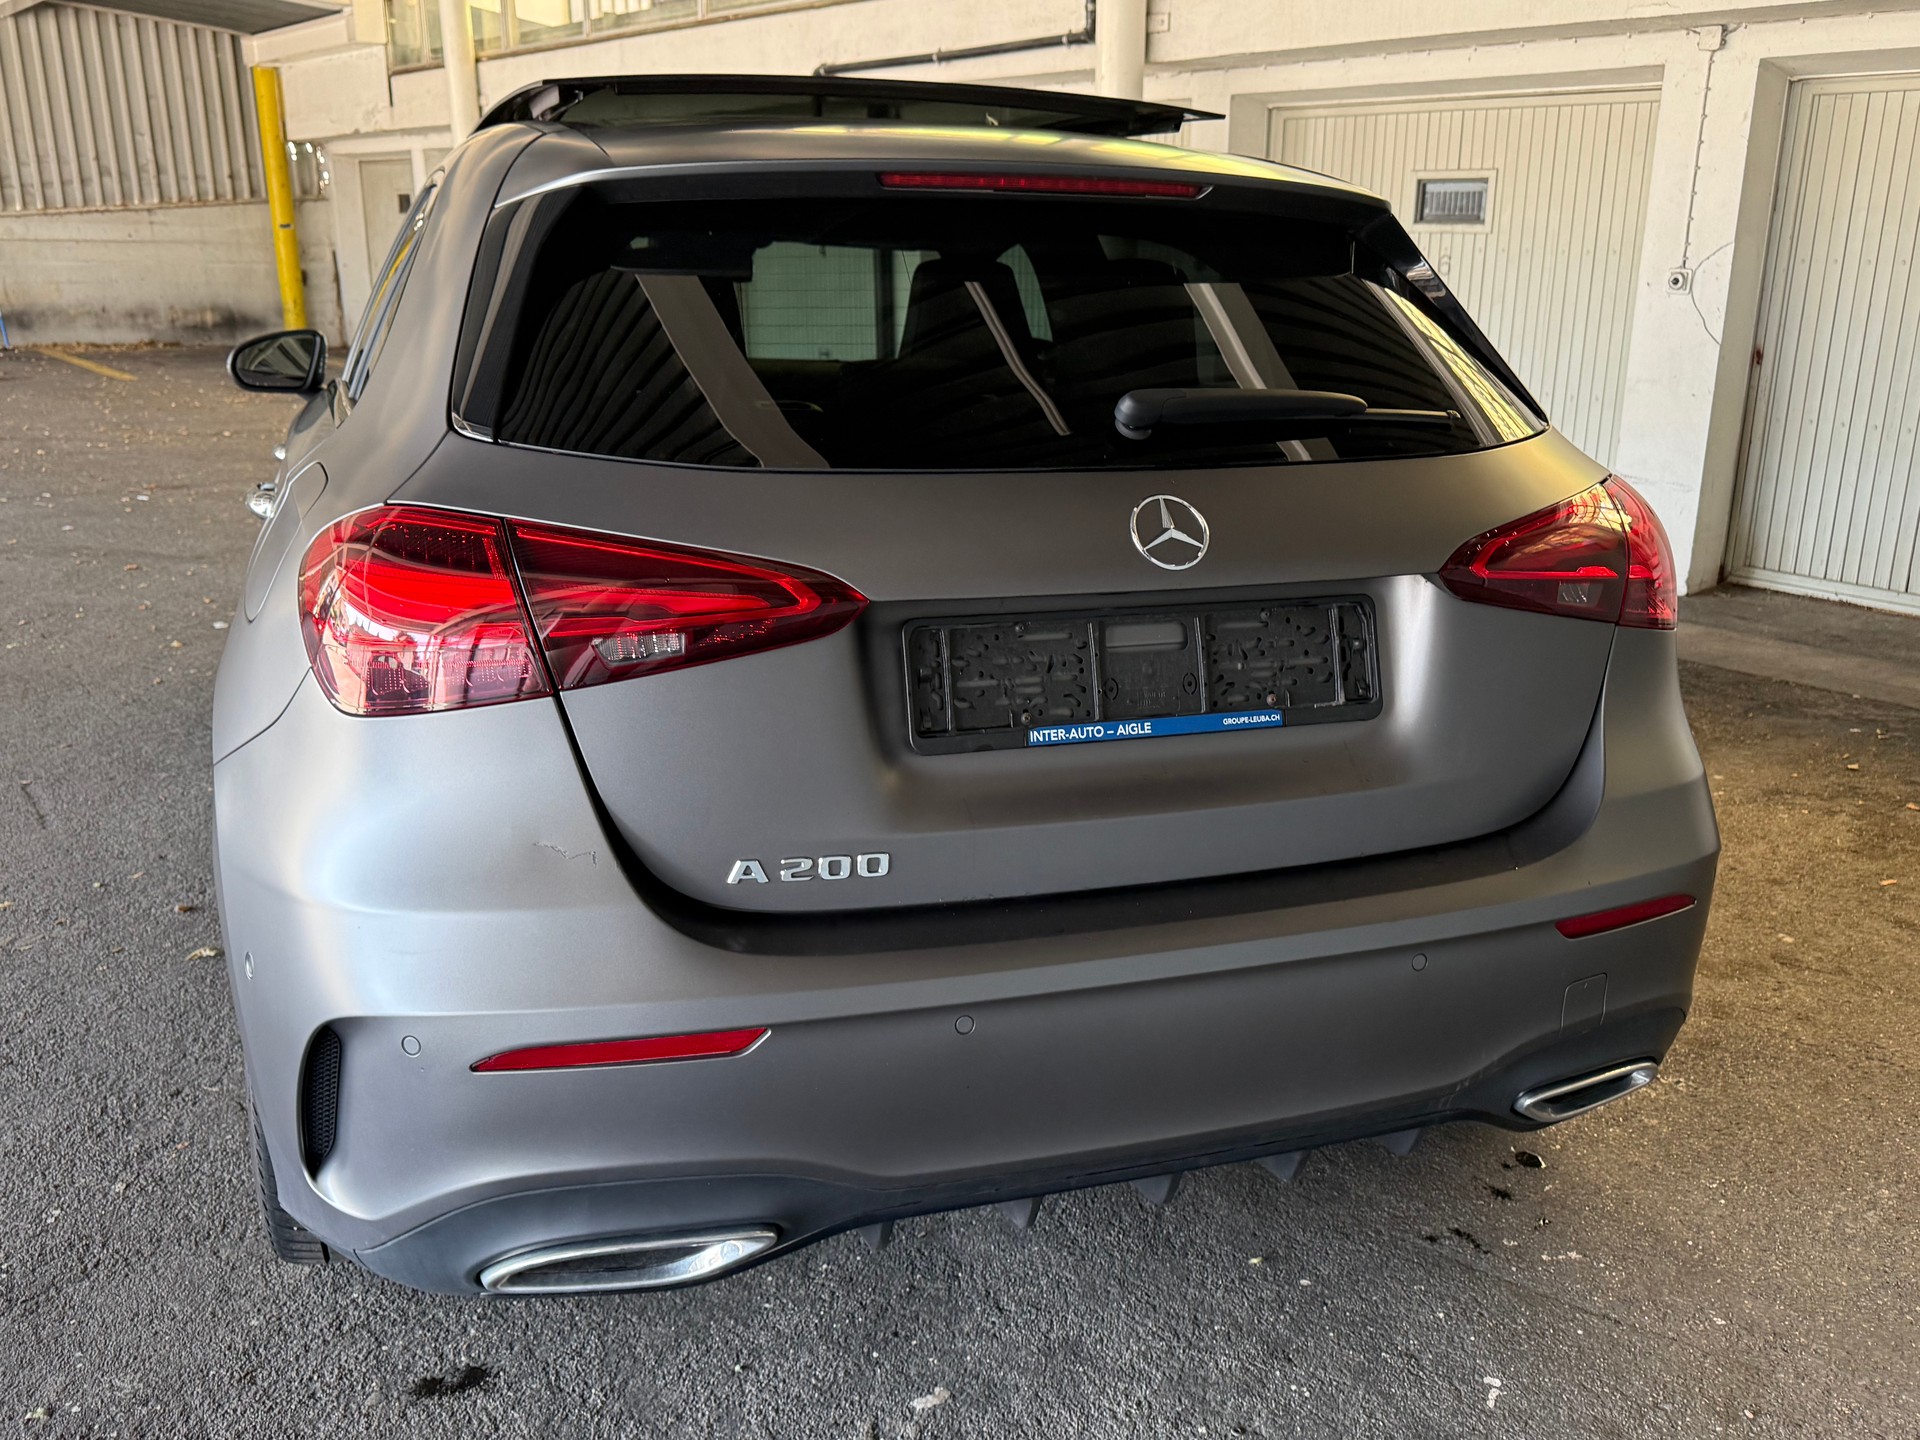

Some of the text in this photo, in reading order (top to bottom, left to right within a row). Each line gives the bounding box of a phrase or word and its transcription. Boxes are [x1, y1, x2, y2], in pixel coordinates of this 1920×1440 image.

[1223, 714, 1280, 725] GROUPE-LEUBA.CH
[1030, 726, 1104, 742] INTER-AUTO
[1117, 722, 1152, 736] AIGLE
[727, 852, 890, 884] A 200
